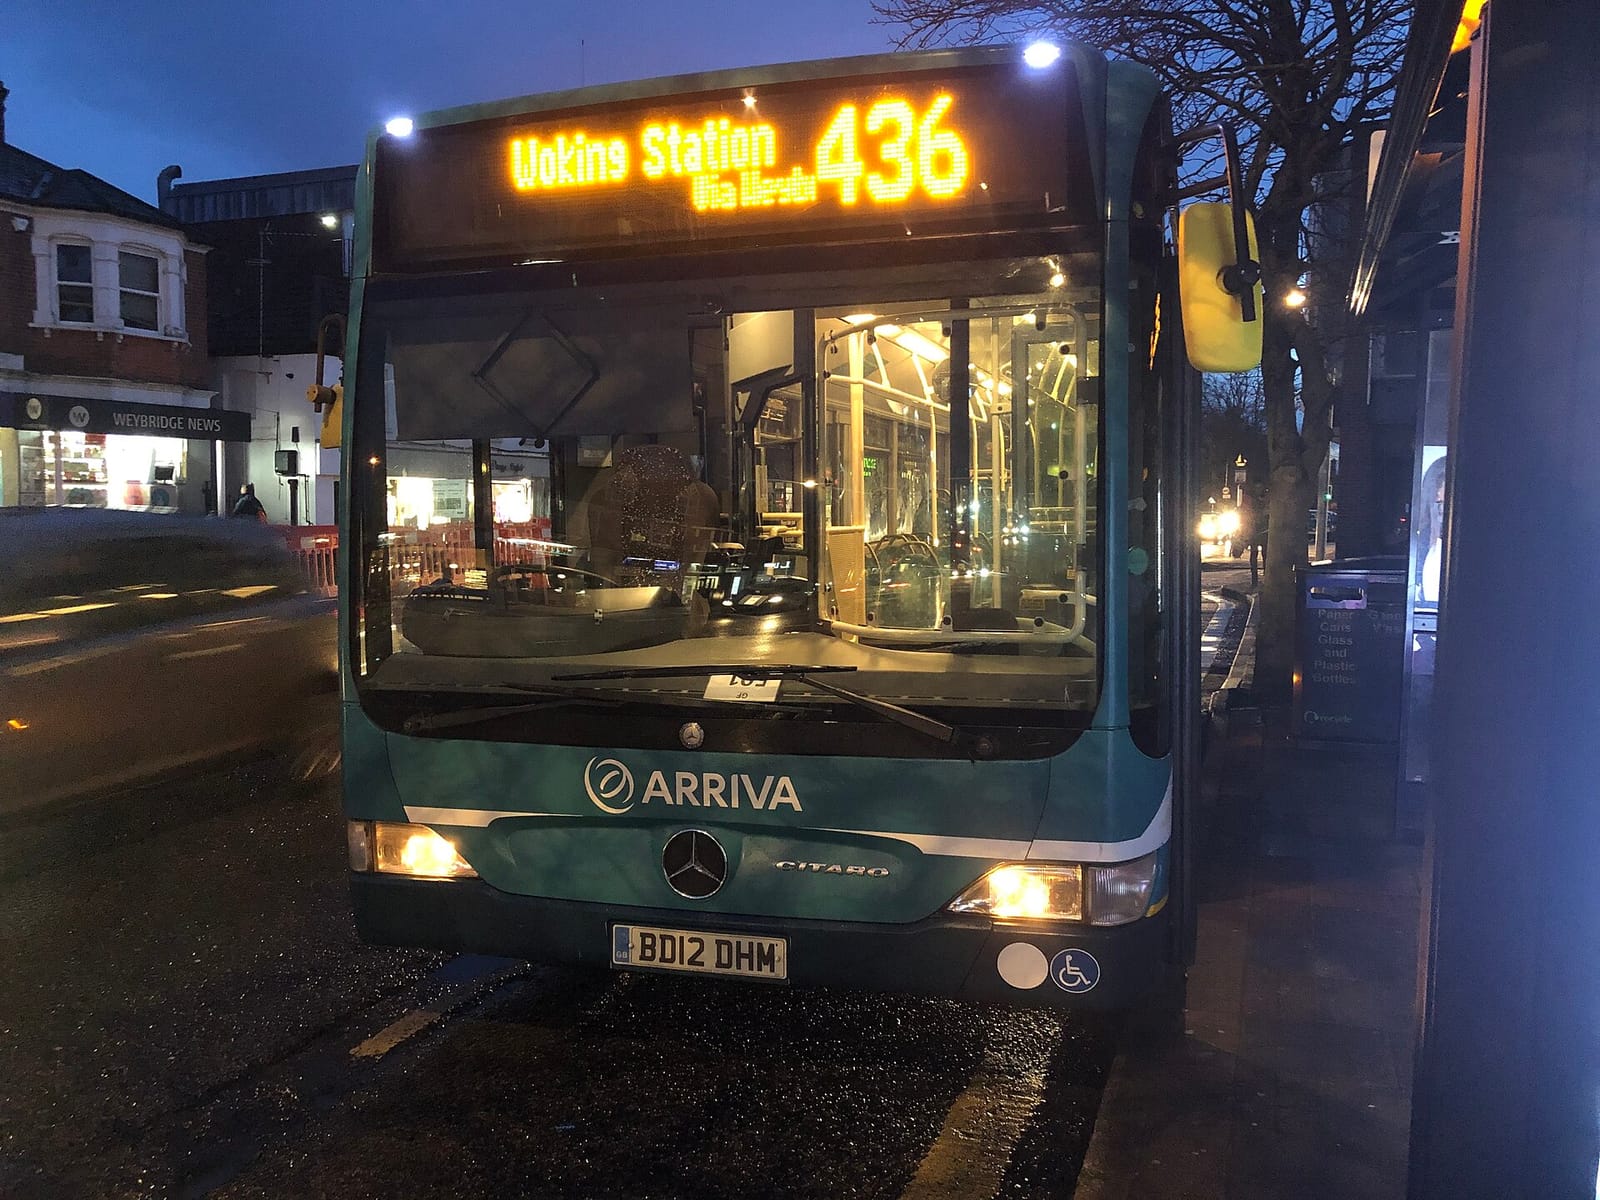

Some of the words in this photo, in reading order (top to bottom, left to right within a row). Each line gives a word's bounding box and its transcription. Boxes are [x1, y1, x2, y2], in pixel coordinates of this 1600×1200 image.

[641, 117, 776, 177] Station
[815, 95, 968, 206] 436
[113, 412, 184, 430] WEYBRIDGE
[188, 418, 221, 432] NEWS
[1318, 609, 1354, 621] Paper
[1320, 622, 1352, 633] Cans
[1318, 634, 1353, 646] Glass
[1325, 648, 1347, 658] and
[1313, 660, 1356, 671] Plastic
[641, 769, 803, 812] ARRIVA
[774, 859, 890, 878] CITARO
[639, 932, 705, 967] BD12
[715, 938, 776, 973] DHM
